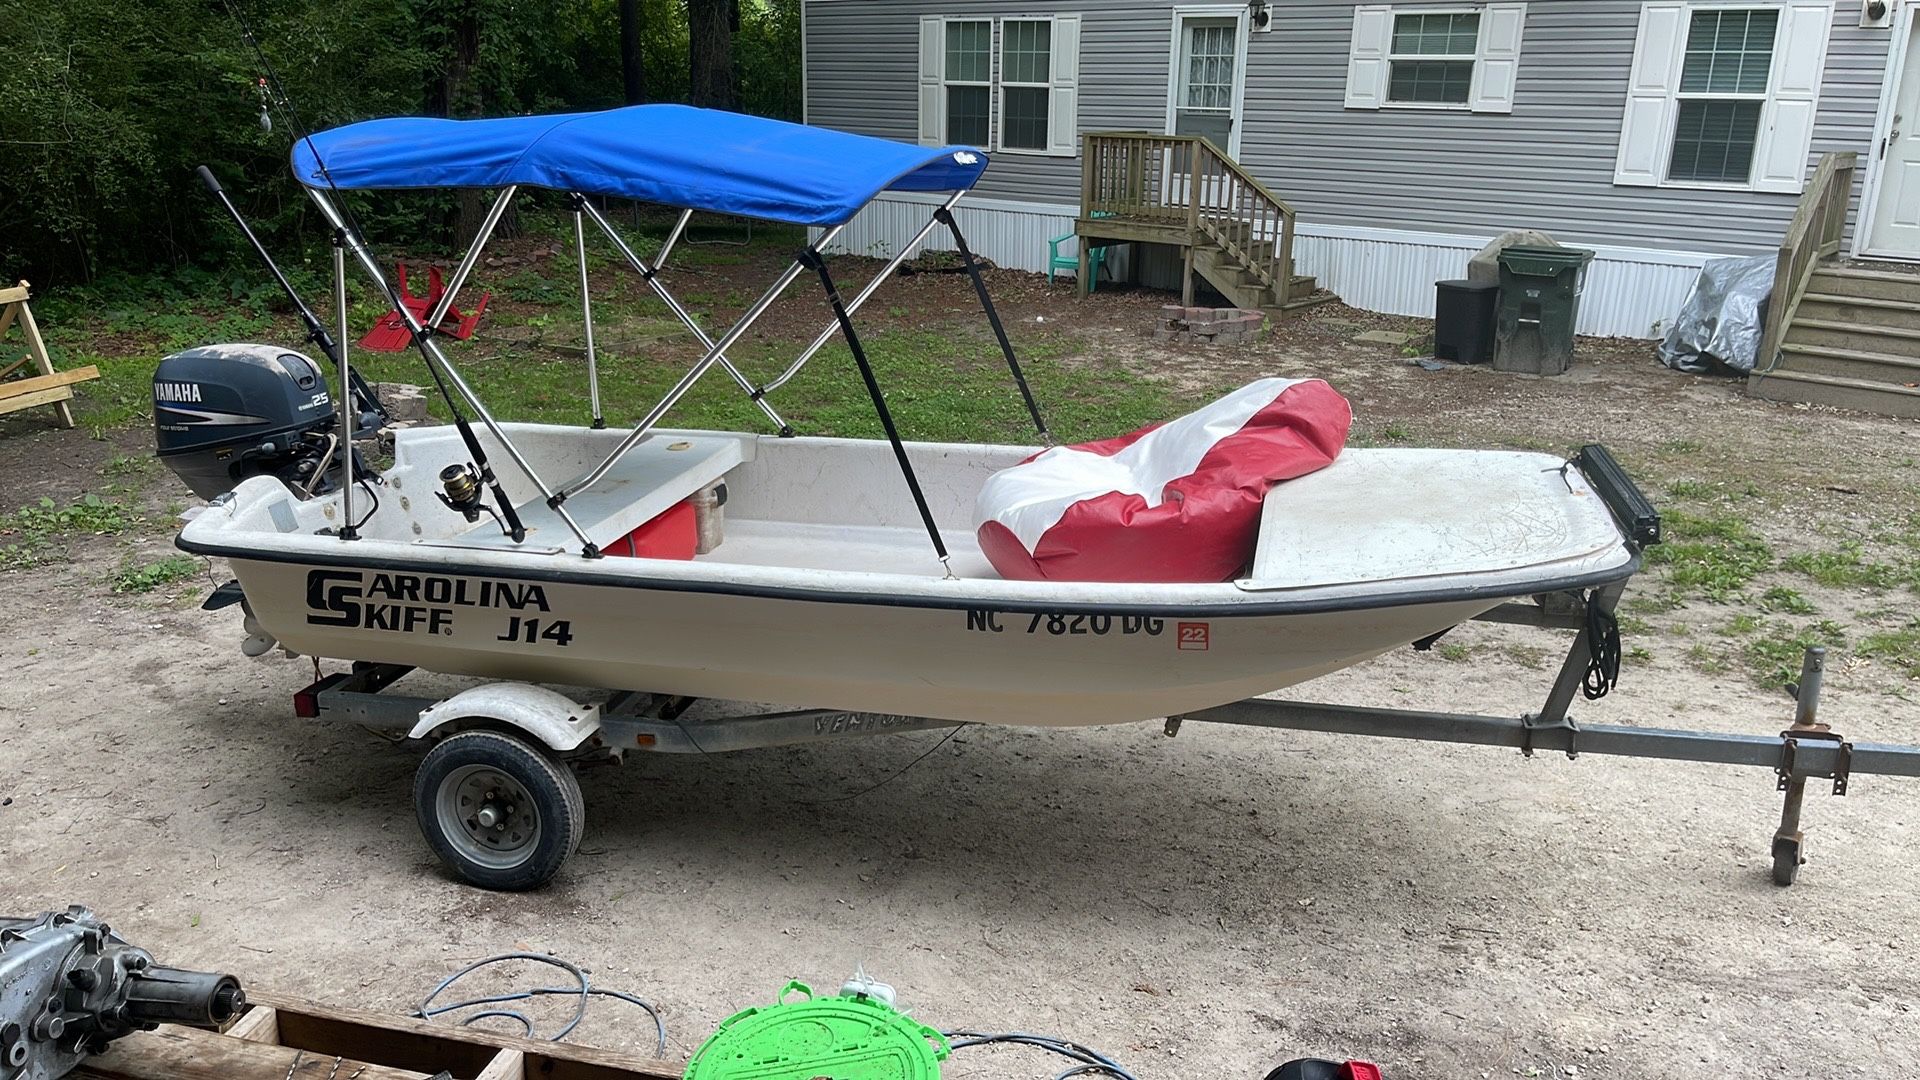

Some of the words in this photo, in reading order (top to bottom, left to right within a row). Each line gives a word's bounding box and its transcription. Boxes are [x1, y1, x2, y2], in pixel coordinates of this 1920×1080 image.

[154, 383, 202, 402] YAMAHA
[312, 391, 329, 406] 25
[307, 570, 551, 612] CAROLINA
[497, 616, 573, 646] J14
[967, 610, 1003, 632] NC
[1026, 613, 1111, 635] 7820
[1122, 616, 1163, 635] DG
[1181, 627, 1206, 642] 22
